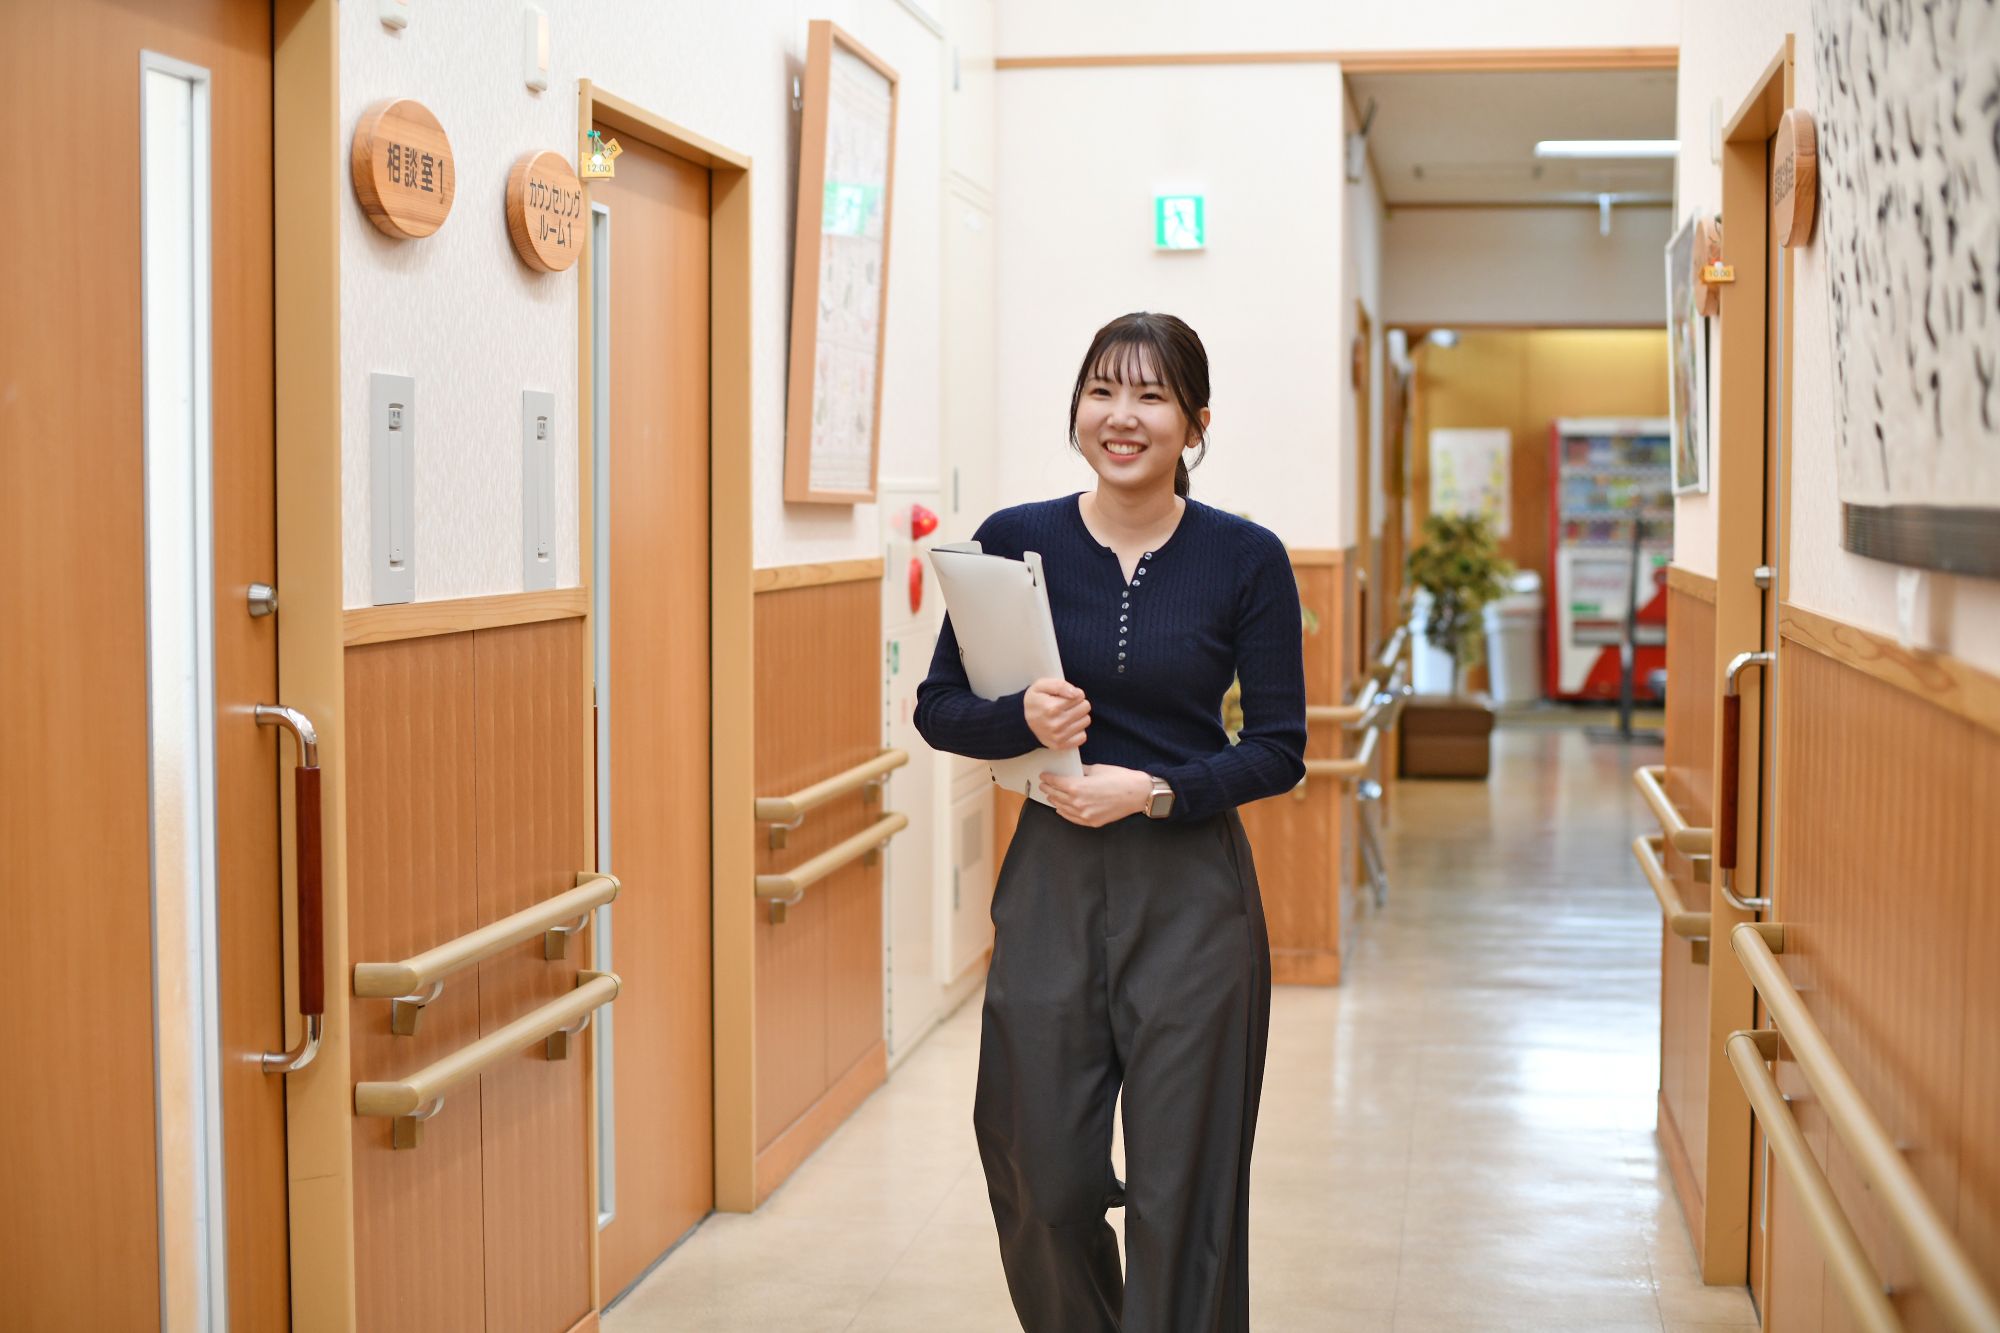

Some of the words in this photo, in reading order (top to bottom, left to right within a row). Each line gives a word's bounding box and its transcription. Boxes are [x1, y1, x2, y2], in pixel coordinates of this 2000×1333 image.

[387, 142, 443, 194] 相談室1
[529, 177, 580, 218] カウンセリング
[540, 214, 571, 248] ルーム1
